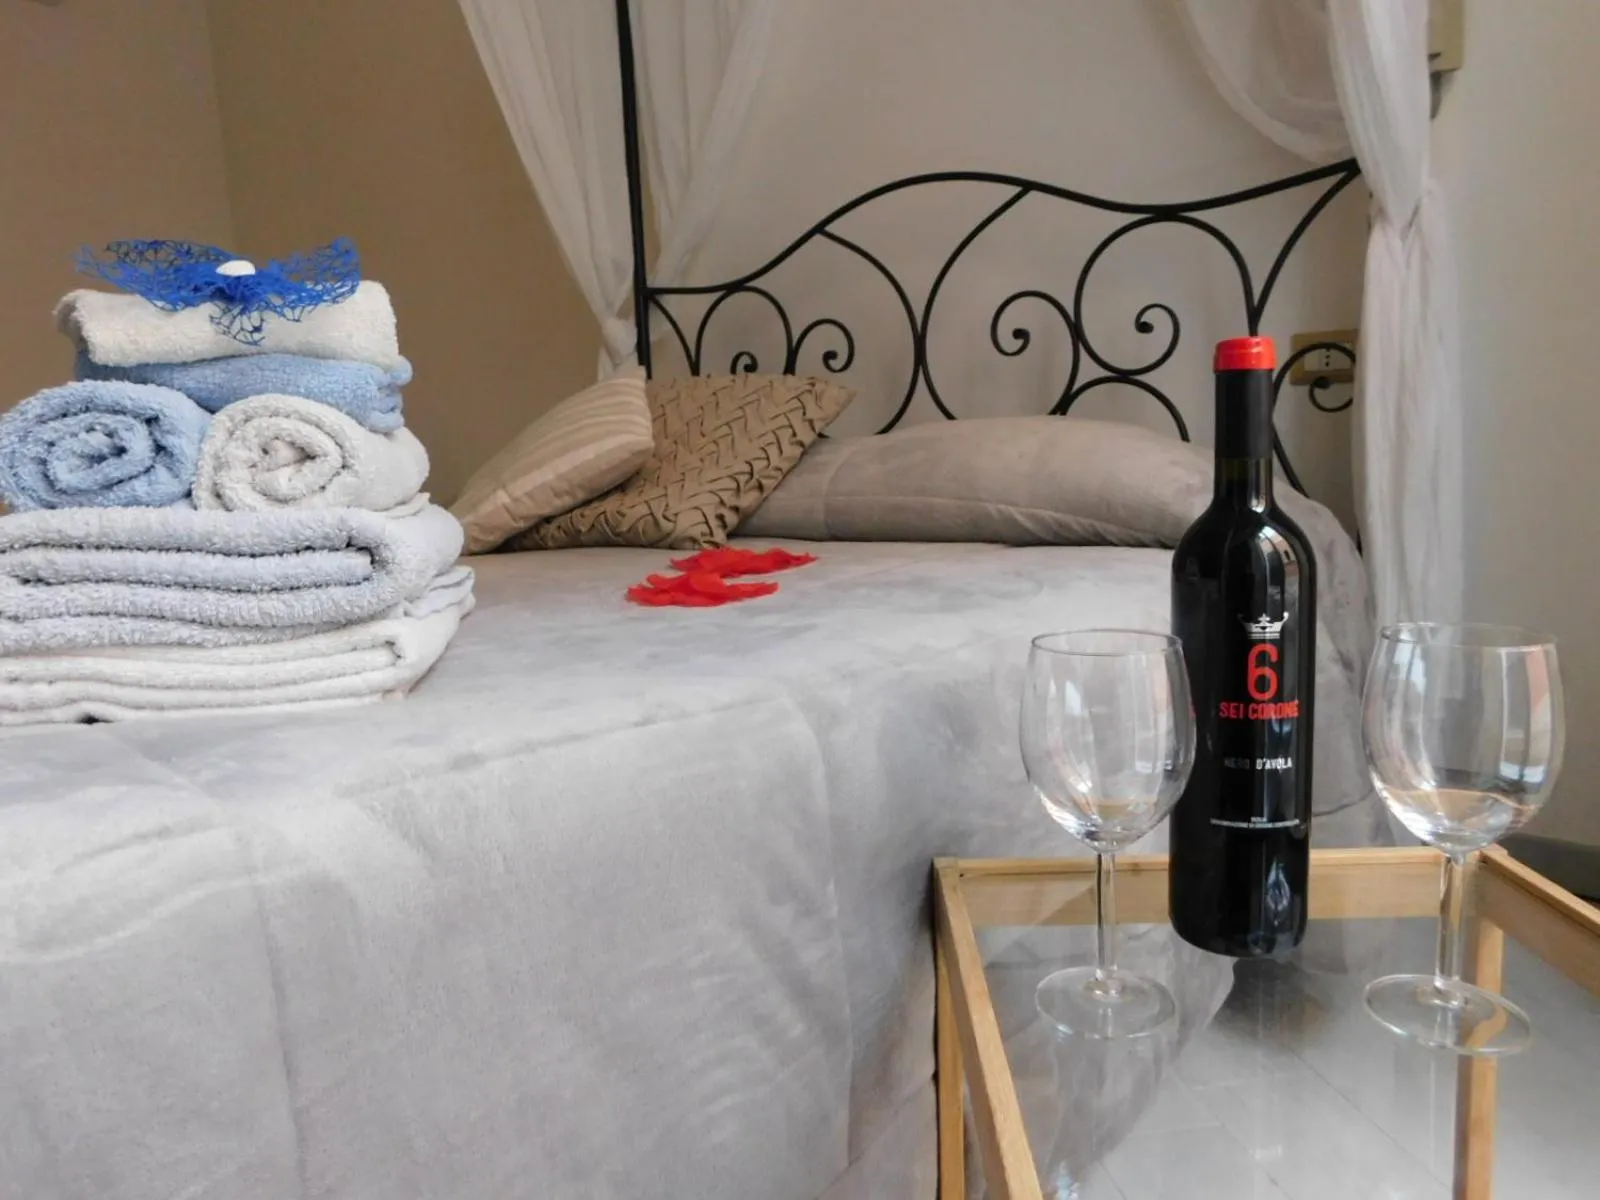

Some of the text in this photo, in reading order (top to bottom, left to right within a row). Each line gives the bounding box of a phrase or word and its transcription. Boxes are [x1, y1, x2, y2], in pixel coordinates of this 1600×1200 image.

[1247, 643, 1279, 701] 6
[1219, 700, 1299, 720] SEI CORONE
[1256, 757, 1292, 770] D'AVOLA
